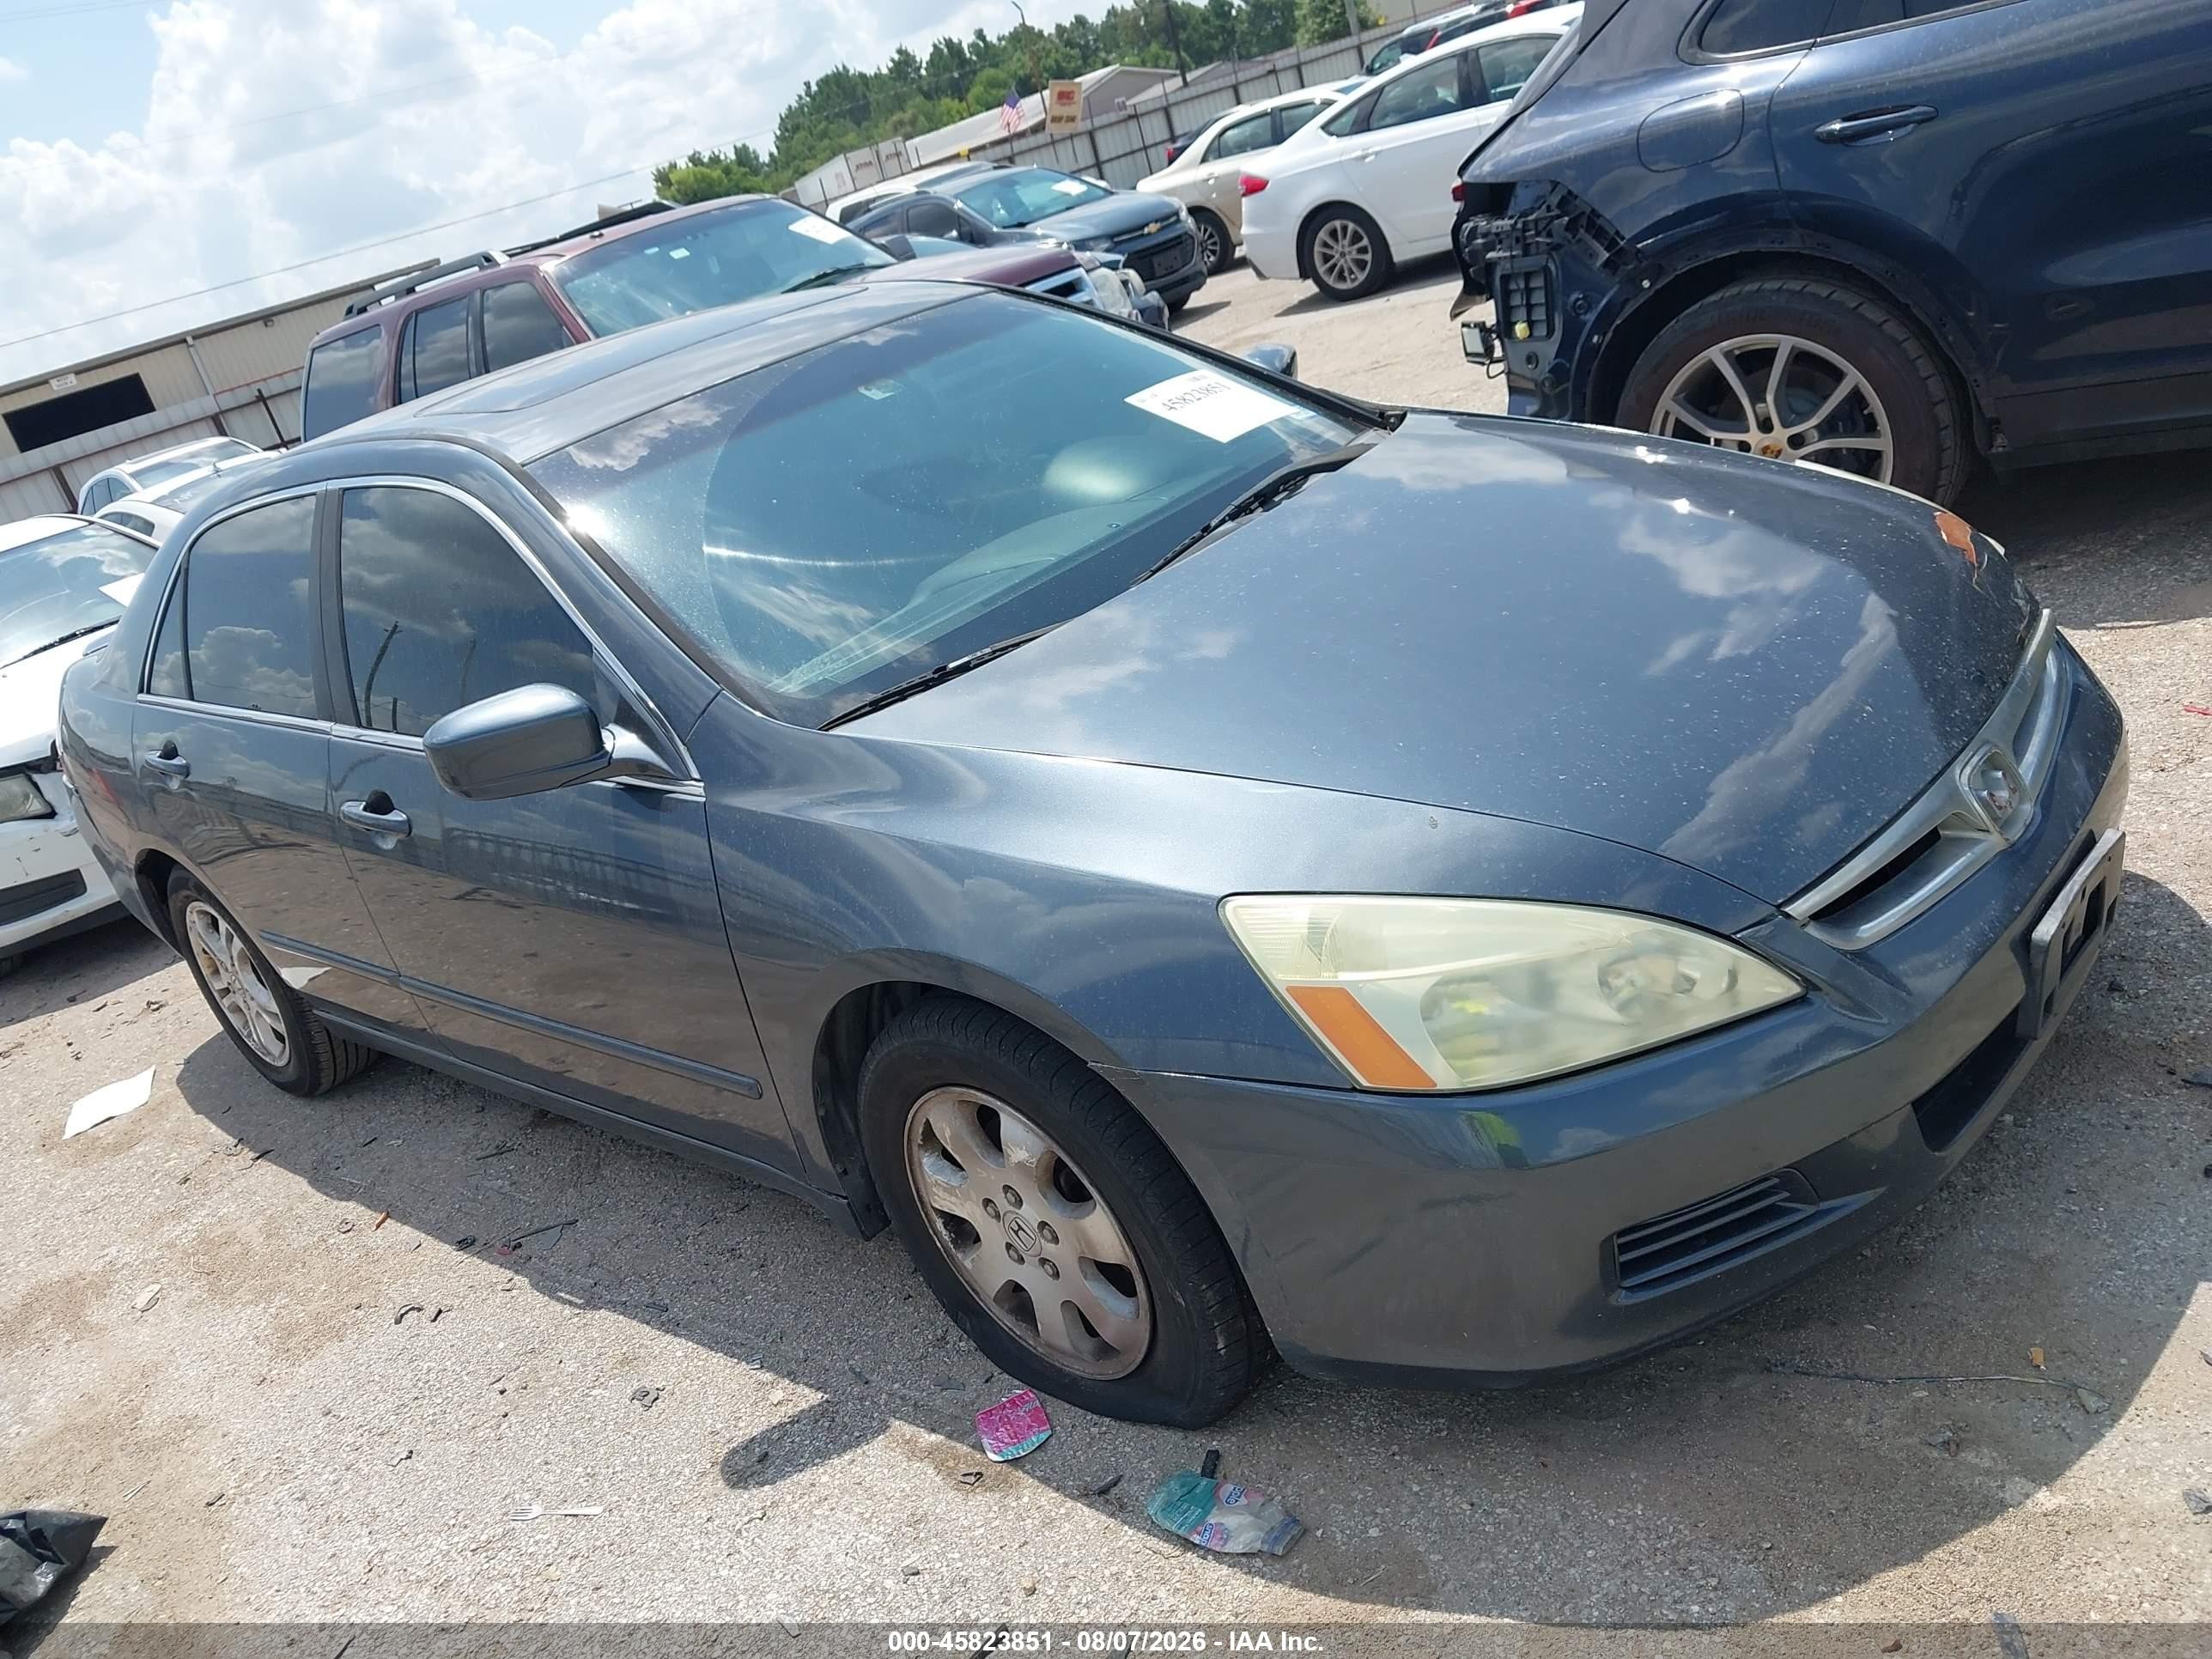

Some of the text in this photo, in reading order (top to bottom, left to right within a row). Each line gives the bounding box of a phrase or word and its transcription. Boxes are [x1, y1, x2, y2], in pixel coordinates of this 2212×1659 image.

[1161, 382, 1231, 411] 45823851
[1226, 1486, 1243, 1504] pple
[1200, 1523, 1213, 1547] snap
